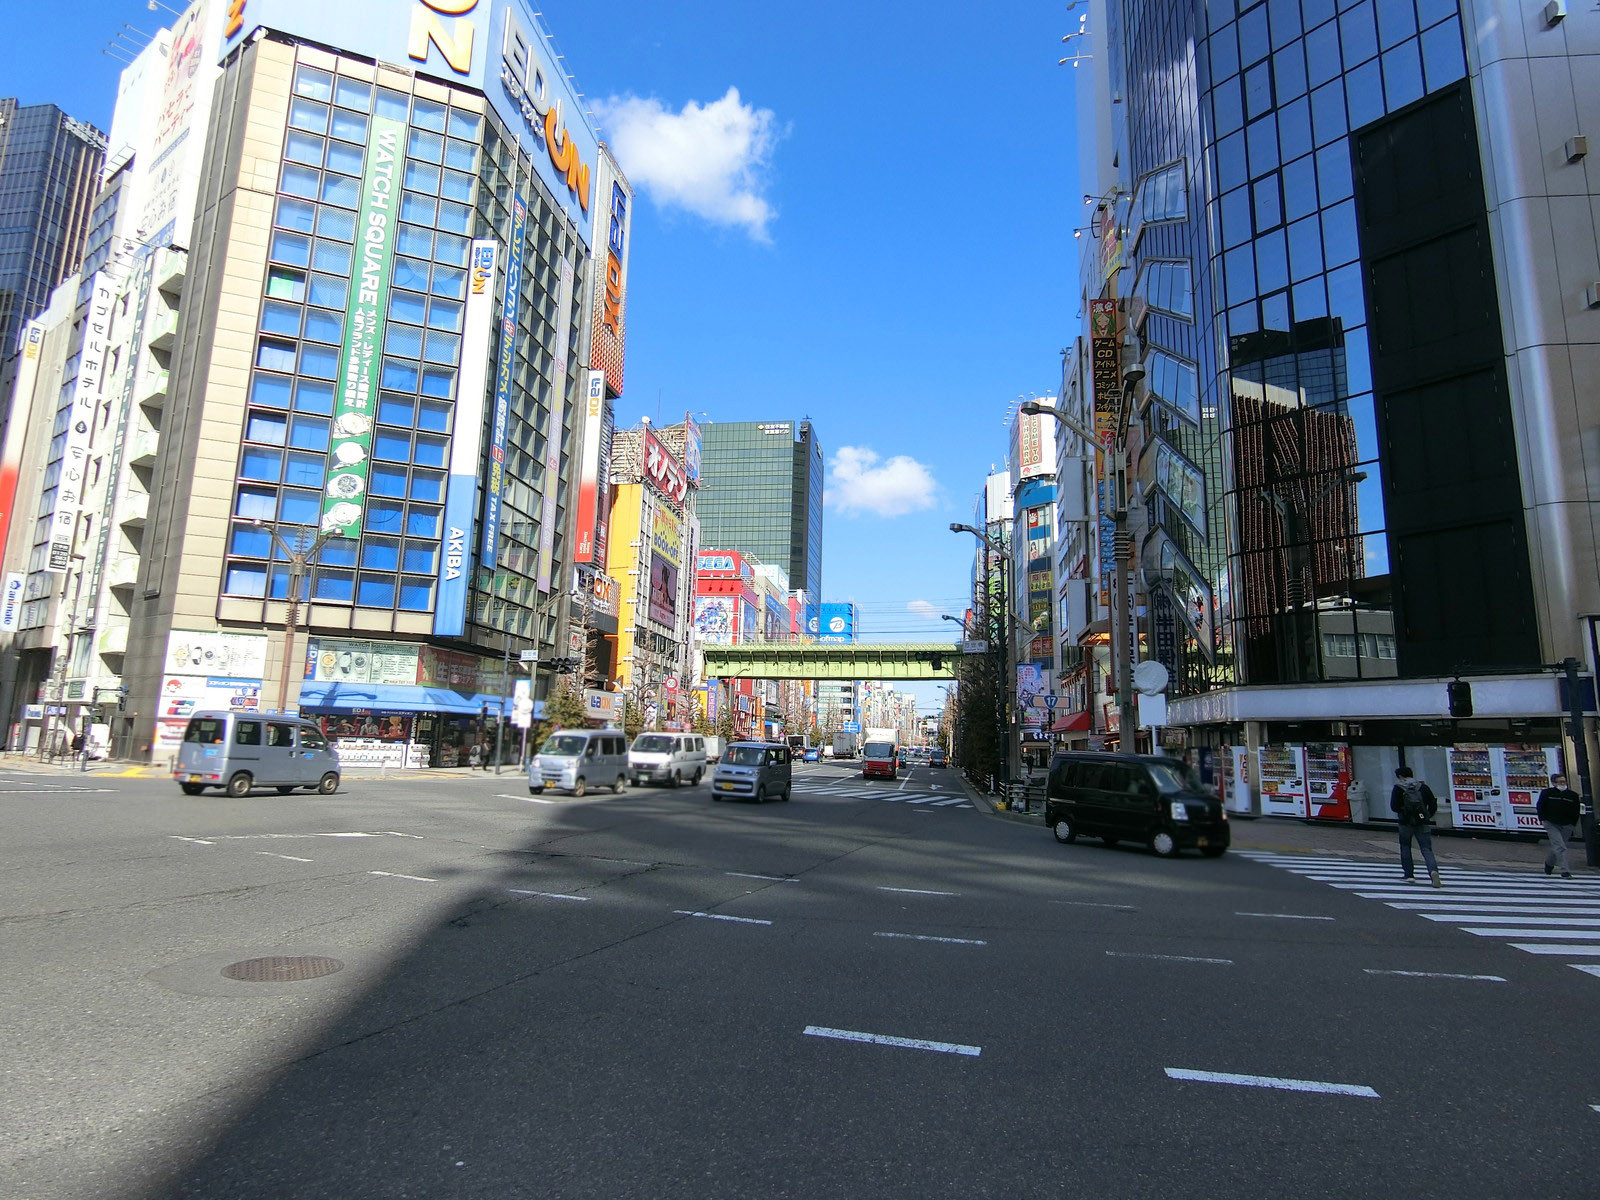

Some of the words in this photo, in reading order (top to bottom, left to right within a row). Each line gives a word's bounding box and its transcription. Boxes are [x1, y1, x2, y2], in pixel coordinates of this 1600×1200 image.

[502, 6, 591, 211] EDION
[372, 129, 398, 210] WATCH
[359, 211, 388, 307] SQUARE
[473, 246, 494, 295] EDION
[506, 214, 523, 319] テレビ・パソコン
[1093, 301, 1114, 313] 激安
[80, 287, 110, 409] カプセルホテル
[1094, 340, 1115, 348] ゲーム
[1097, 350, 1113, 358] CD
[1095, 360, 1117, 368] アイドル
[1095, 371, 1117, 379] アニメ
[1023, 414, 1031, 464] KIHABARA
[492, 445, 505, 463] 1F
[1032, 448, 1039, 462] TO
[647, 442, 688, 502] オノデン
[489, 497, 498, 521] TAX
[486, 523, 494, 554] FREE
[445, 526, 465, 581] AKIBA
[697, 556, 736, 571] SEGA
[4, 590, 17, 625] animate
[1046, 697, 1055, 705] 17
[1462, 814, 1496, 824] KIRIN
